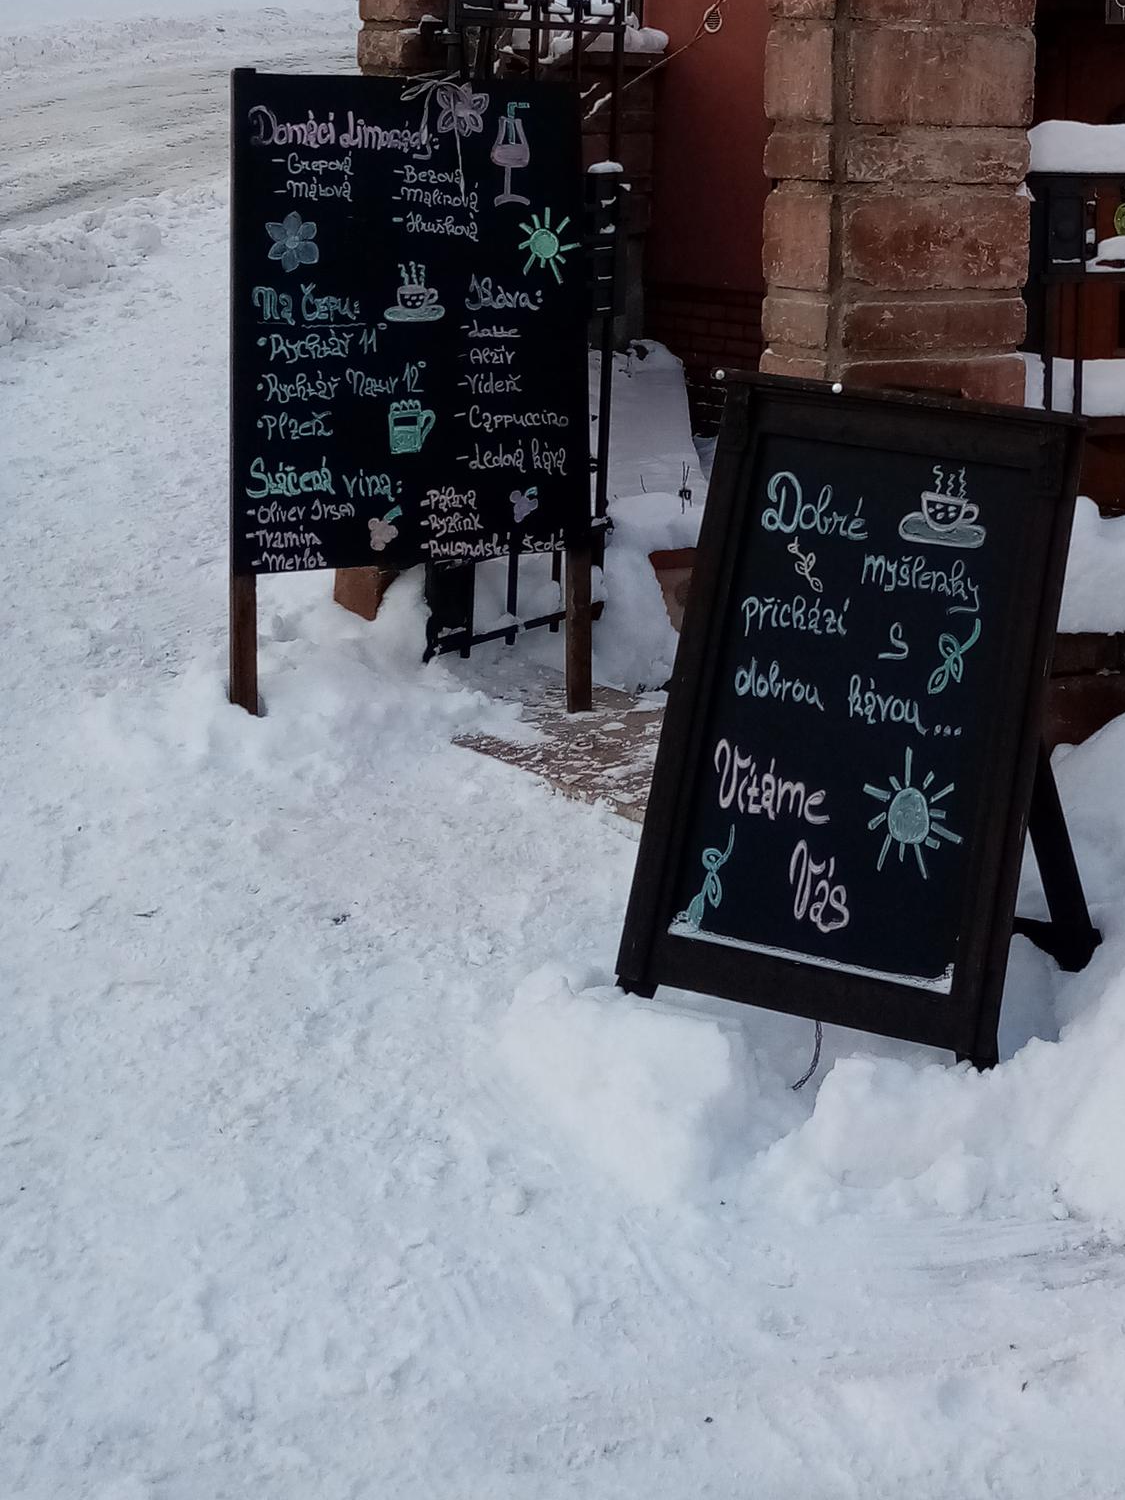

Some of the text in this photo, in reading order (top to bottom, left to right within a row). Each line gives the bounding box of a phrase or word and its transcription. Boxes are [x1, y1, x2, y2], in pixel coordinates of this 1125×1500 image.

[760, 470, 869, 541] Dobré
[734, 655, 826, 712] dobrou
[713, 737, 831, 825] Vítáme
[788, 838, 850, 934] Vás
